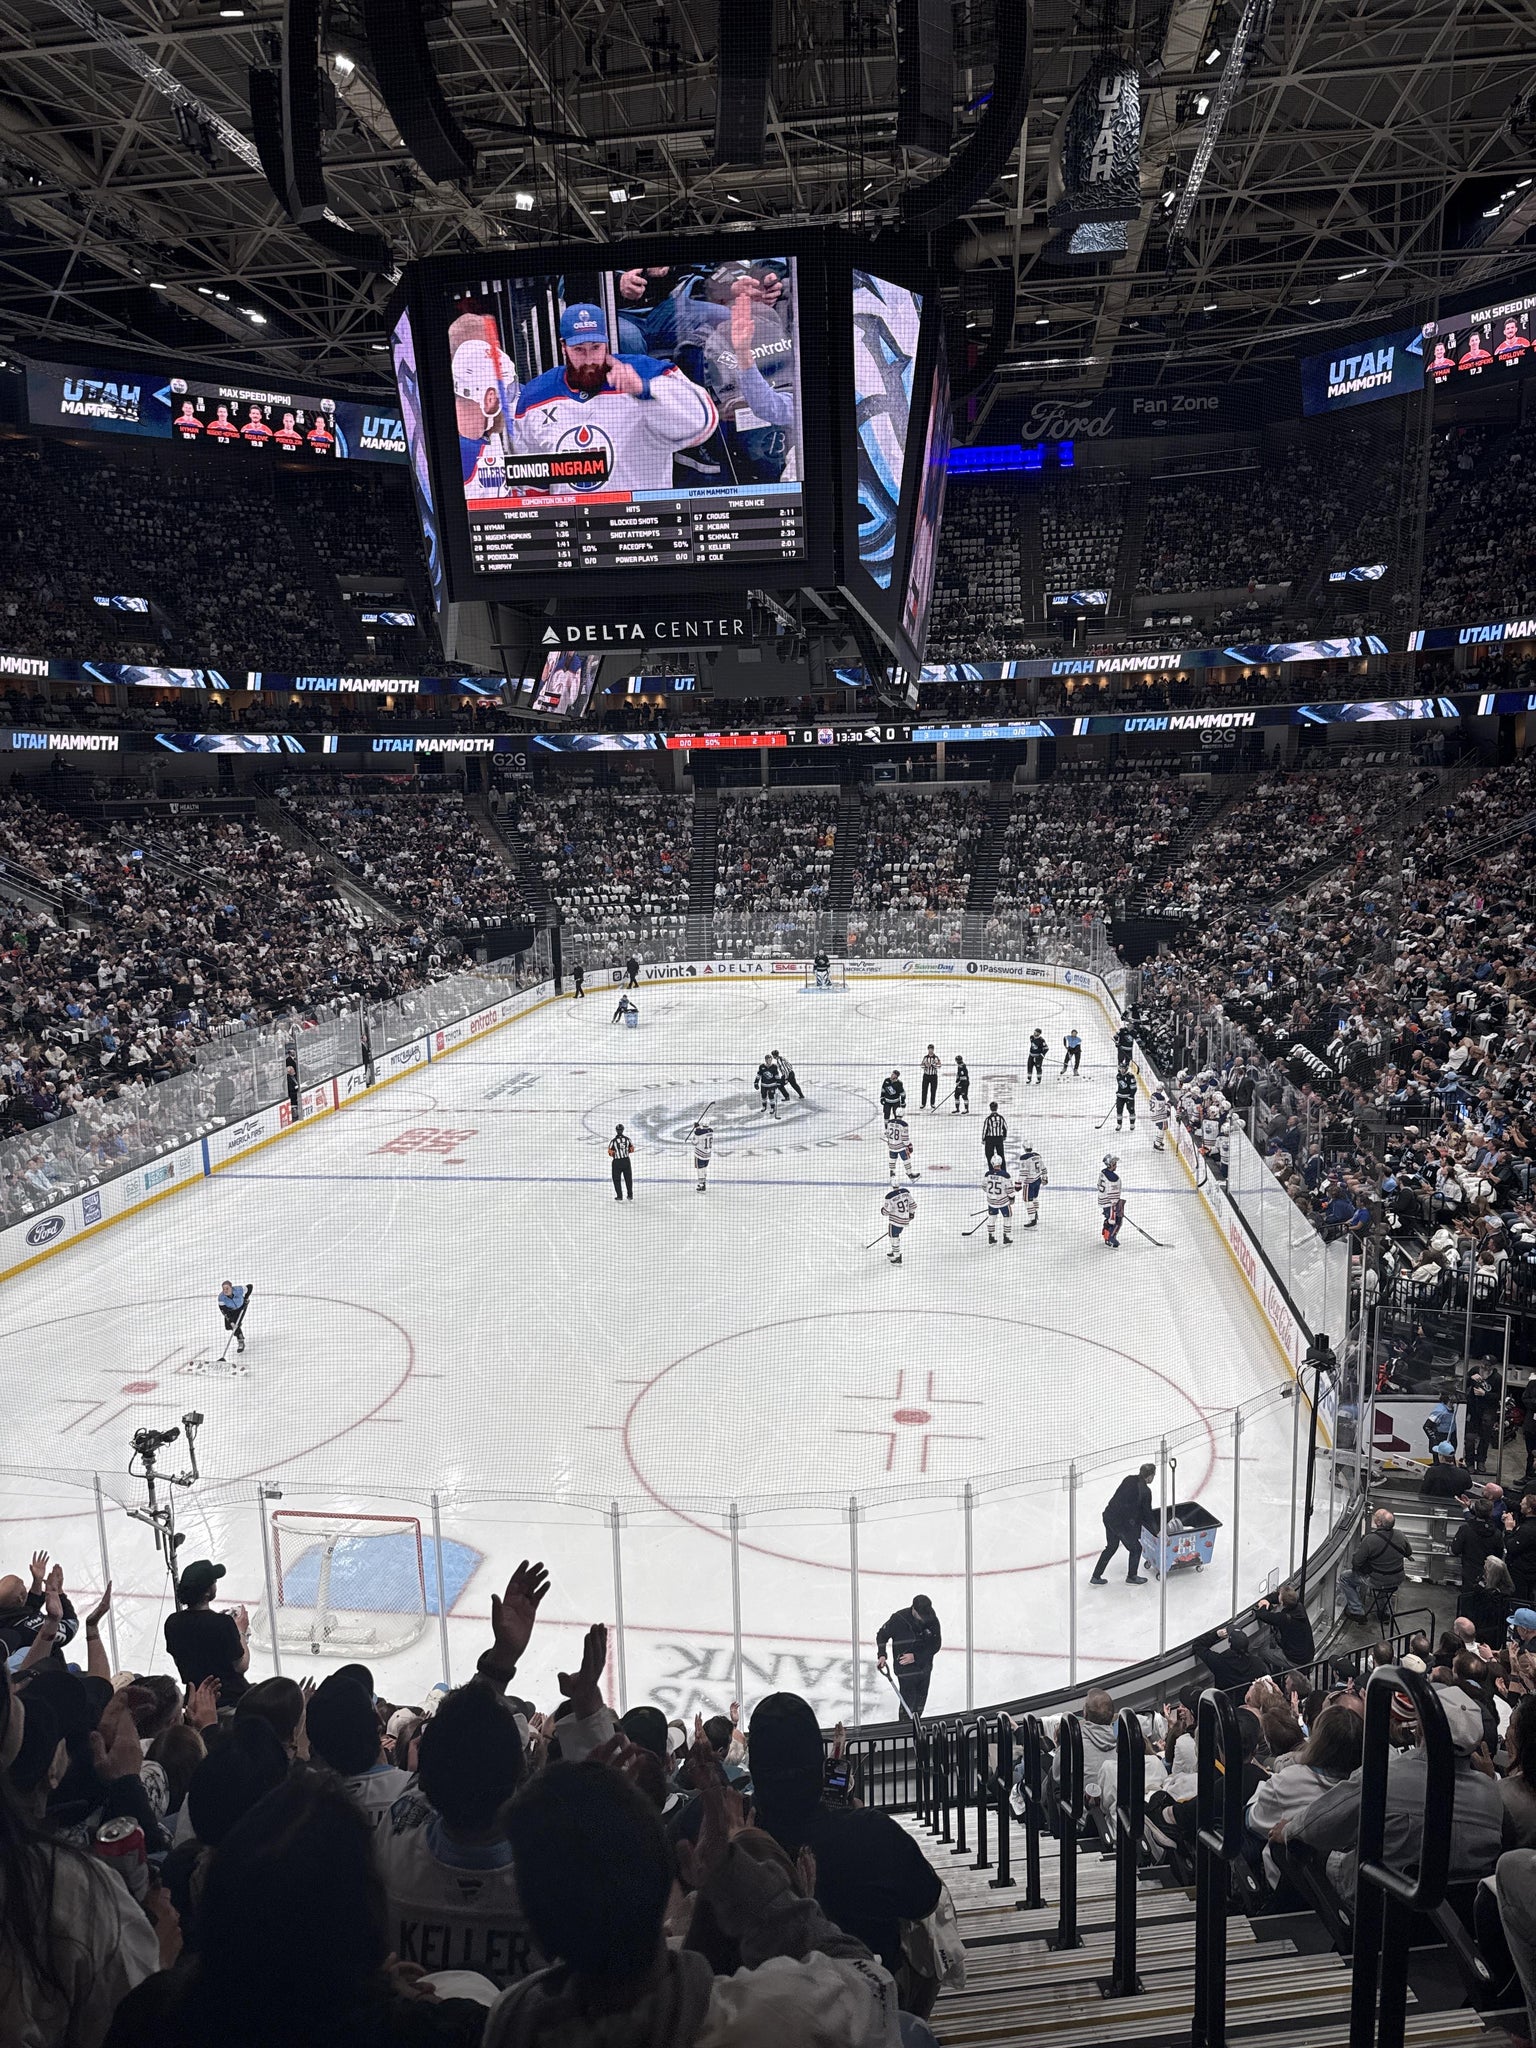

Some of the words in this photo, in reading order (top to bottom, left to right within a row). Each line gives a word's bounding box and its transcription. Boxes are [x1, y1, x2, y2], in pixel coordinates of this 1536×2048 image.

[1089, 76, 1121, 182] UTAH
[1471, 310, 1491, 323] MAX
[1492, 301, 1522, 318] SPEED
[573, 321, 597, 329] OILERS
[1329, 346, 1394, 384] UTAH
[1328, 370, 1392, 398] MAMMOTH
[63, 377, 141, 408] UTAH
[219, 387, 239, 399] MAX
[239, 389, 267, 403] SPEED
[268, 393, 291, 405] (MPH)
[1133, 398, 1167, 414] Fan
[1172, 395, 1218, 411] Zone
[1022, 400, 1116, 440] Ford
[506, 463, 549, 480] CONNOR
[551, 459, 604, 477] INGRAM
[706, 487, 738, 496] MAMMOTH
[521, 497, 554, 506] EDMONTON
[554, 496, 576, 505] OILERS
[744, 499, 754, 507] ON
[519, 511, 528, 519] ON
[638, 517, 658, 525] SHOTS
[706, 512, 730, 520] CROUSE
[781, 519, 795, 527] 1:24
[556, 530, 570, 538] 1:36
[610, 531, 626, 539] SHOT
[627, 530, 660, 538] ATTEMPTS
[619, 543, 645, 551] FACEOFF
[708, 543, 731, 551] KELLER
[584, 557, 597, 565] 0/0
[615, 556, 638, 564] POWER
[675, 553, 688, 561] 0/0
[567, 624, 645, 643] DELTA
[654, 619, 745, 639] CENTER
[1459, 624, 1504, 644] UTAH
[1051, 660, 1094, 675] UTAH
[1096, 654, 1181, 673] MAMMOTH
[295, 677, 337, 692] UTAH
[339, 677, 419, 694] MAMMOTH
[674, 677, 695, 691] UT
[1125, 717, 1167, 732] UTAH
[1169, 712, 1255, 731] MAMMOTH
[804, 731, 812, 742] 0
[836, 733, 863, 743] 13:30
[886, 728, 895, 740] 0
[1200, 728, 1236, 744] G2G
[12, 733, 47, 749] UTAH
[48, 733, 119, 751] MAMMOTH
[372, 738, 413, 752] UTAH
[414, 738, 495, 752] MAMMOTH
[493, 753, 526, 767] G2G
[645, 964, 684, 979] vivint
[719, 963, 763, 973] DELTA
[914, 963, 954, 972] SameDay
[979, 965, 1023, 975] 1Password
[470, 1009, 497, 1034] entrata
[445, 1029, 462, 1042] TOYOTA
[228, 1133, 250, 1149] AMERICA
[250, 1125, 265, 1139] FIRST
[889, 1128, 900, 1140] 28
[988, 1181, 1001, 1194] 25
[34, 1220, 58, 1242] Ford
[1230, 1222, 1256, 1287] verizon
[654, 1642, 880, 1694] BANK
